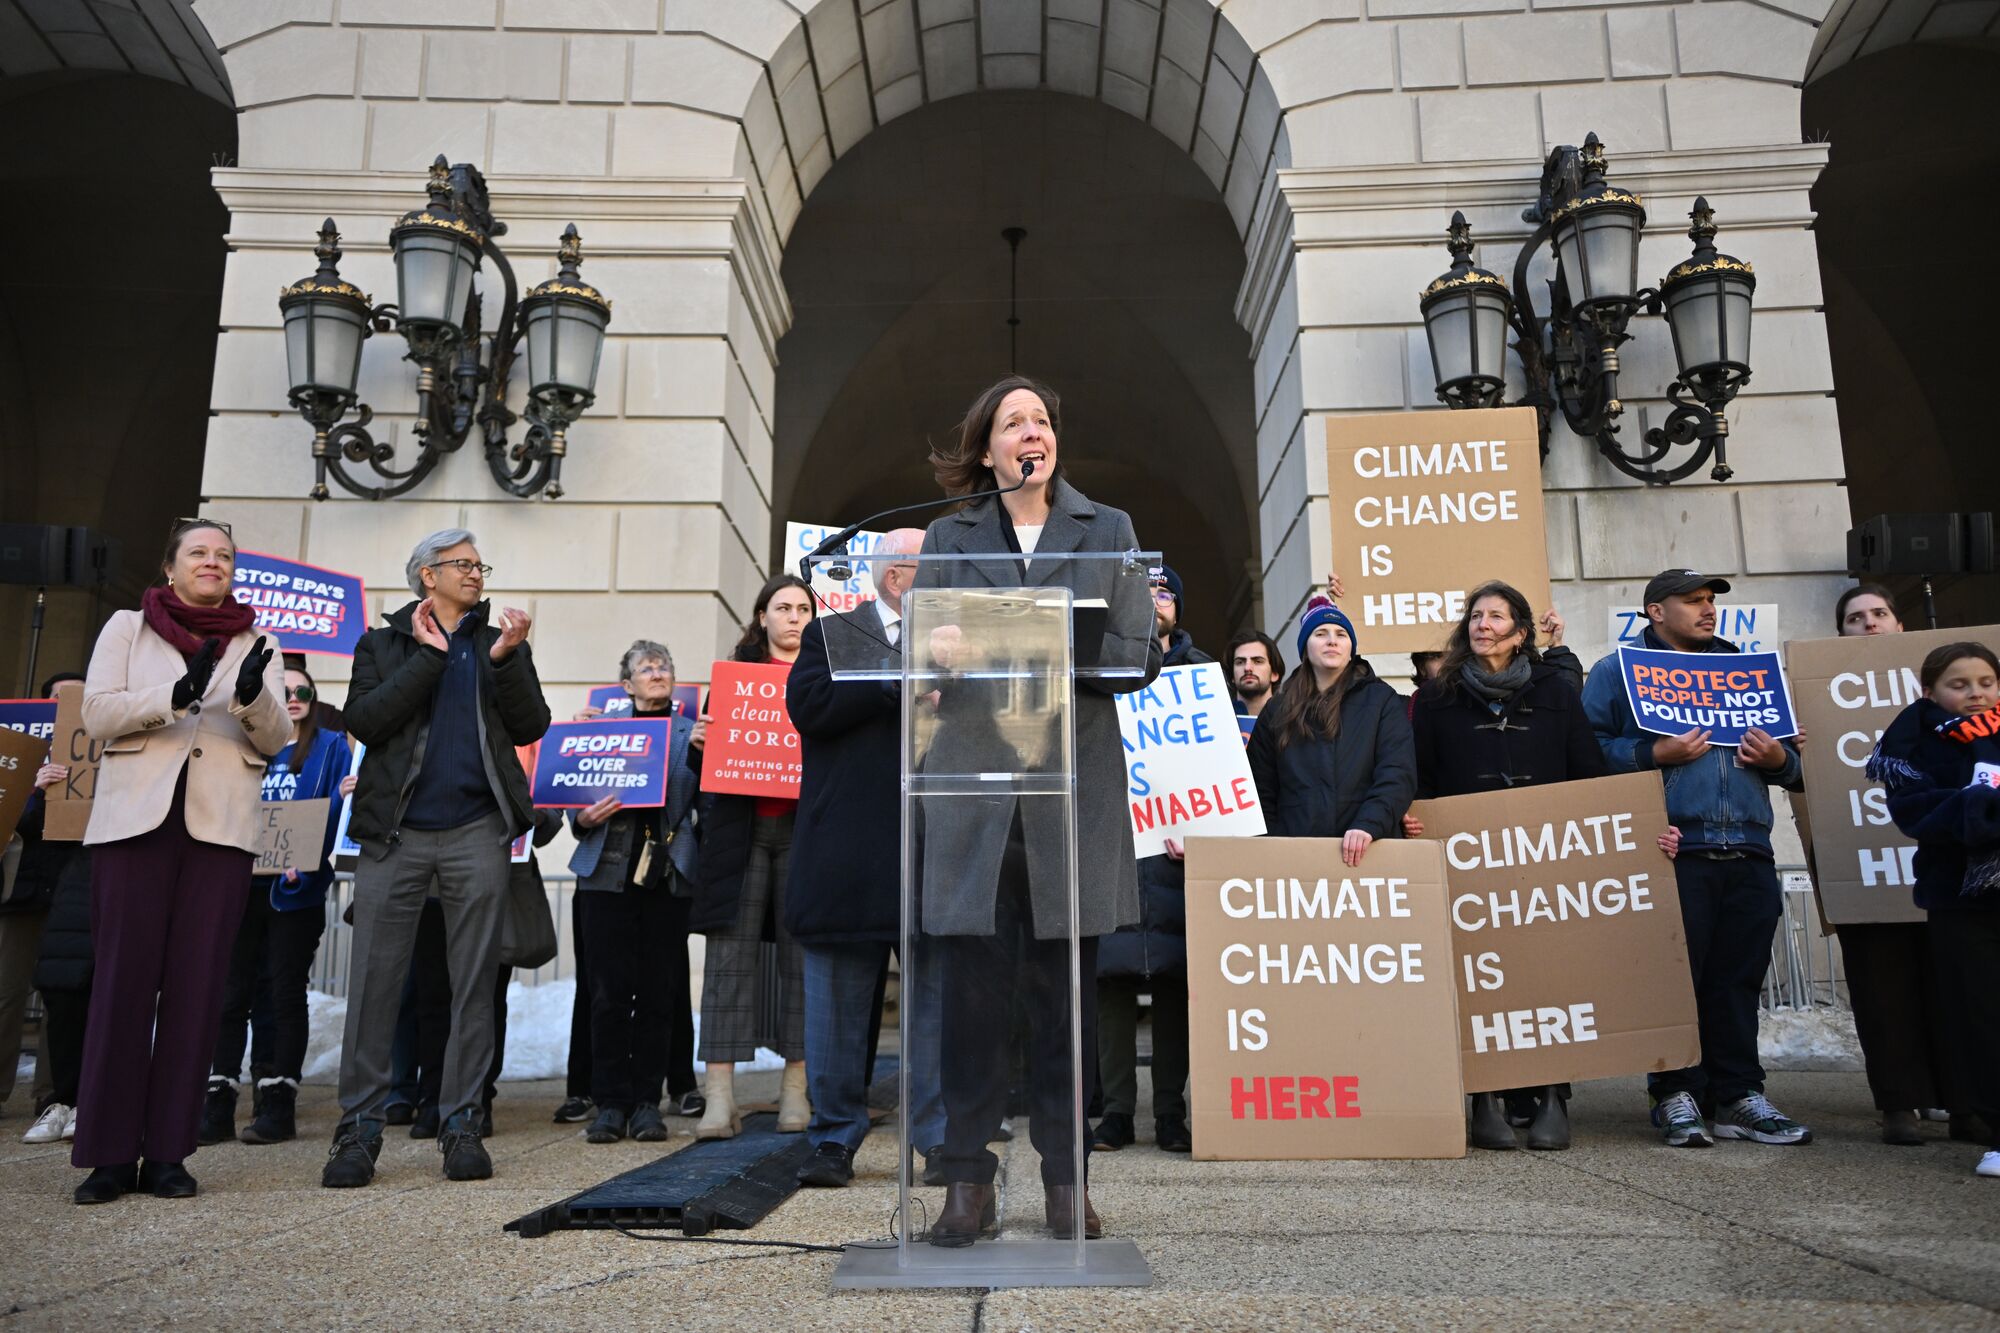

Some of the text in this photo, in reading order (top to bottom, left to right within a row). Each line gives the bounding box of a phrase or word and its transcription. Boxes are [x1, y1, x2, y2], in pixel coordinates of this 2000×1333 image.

[1354, 440, 1508, 478] CLIMATE
[1354, 490, 1519, 528] CHANGE
[1360, 545, 1394, 577] IS
[234, 568, 345, 600] STOP EPA'S
[843, 577, 860, 594] IS
[233, 587, 340, 617] CLIMATE
[1363, 591, 1466, 626] HERE
[1633, 664, 1768, 691] PROTECT
[732, 701, 781, 722] clean
[1636, 685, 1775, 709] PEOPLE, NOT
[1640, 701, 1781, 727] POLLUTERS
[560, 735, 647, 753] PEOPLE
[728, 729, 798, 748] FORC
[1122, 712, 1215, 753] NGE
[552, 773, 648, 787] POLLUTERS
[578, 758, 626, 771] OVER
[715, 769, 739, 779] OUR
[744, 771, 776, 782] KIDS'
[727, 759, 783, 771] FIGHTING
[1849, 787, 1893, 827] IS
[273, 828, 293, 850] IS
[1446, 813, 1636, 870] CLIMATE
[1219, 878, 1411, 919] CLIMATE
[1452, 873, 1654, 932] CHANGE
[1220, 943, 1425, 984] CHANGE
[1463, 952, 1504, 993] IS
[1227, 1008, 1269, 1051] IS
[1470, 1002, 1598, 1054] HERE
[1230, 1075, 1362, 1120] HERE
